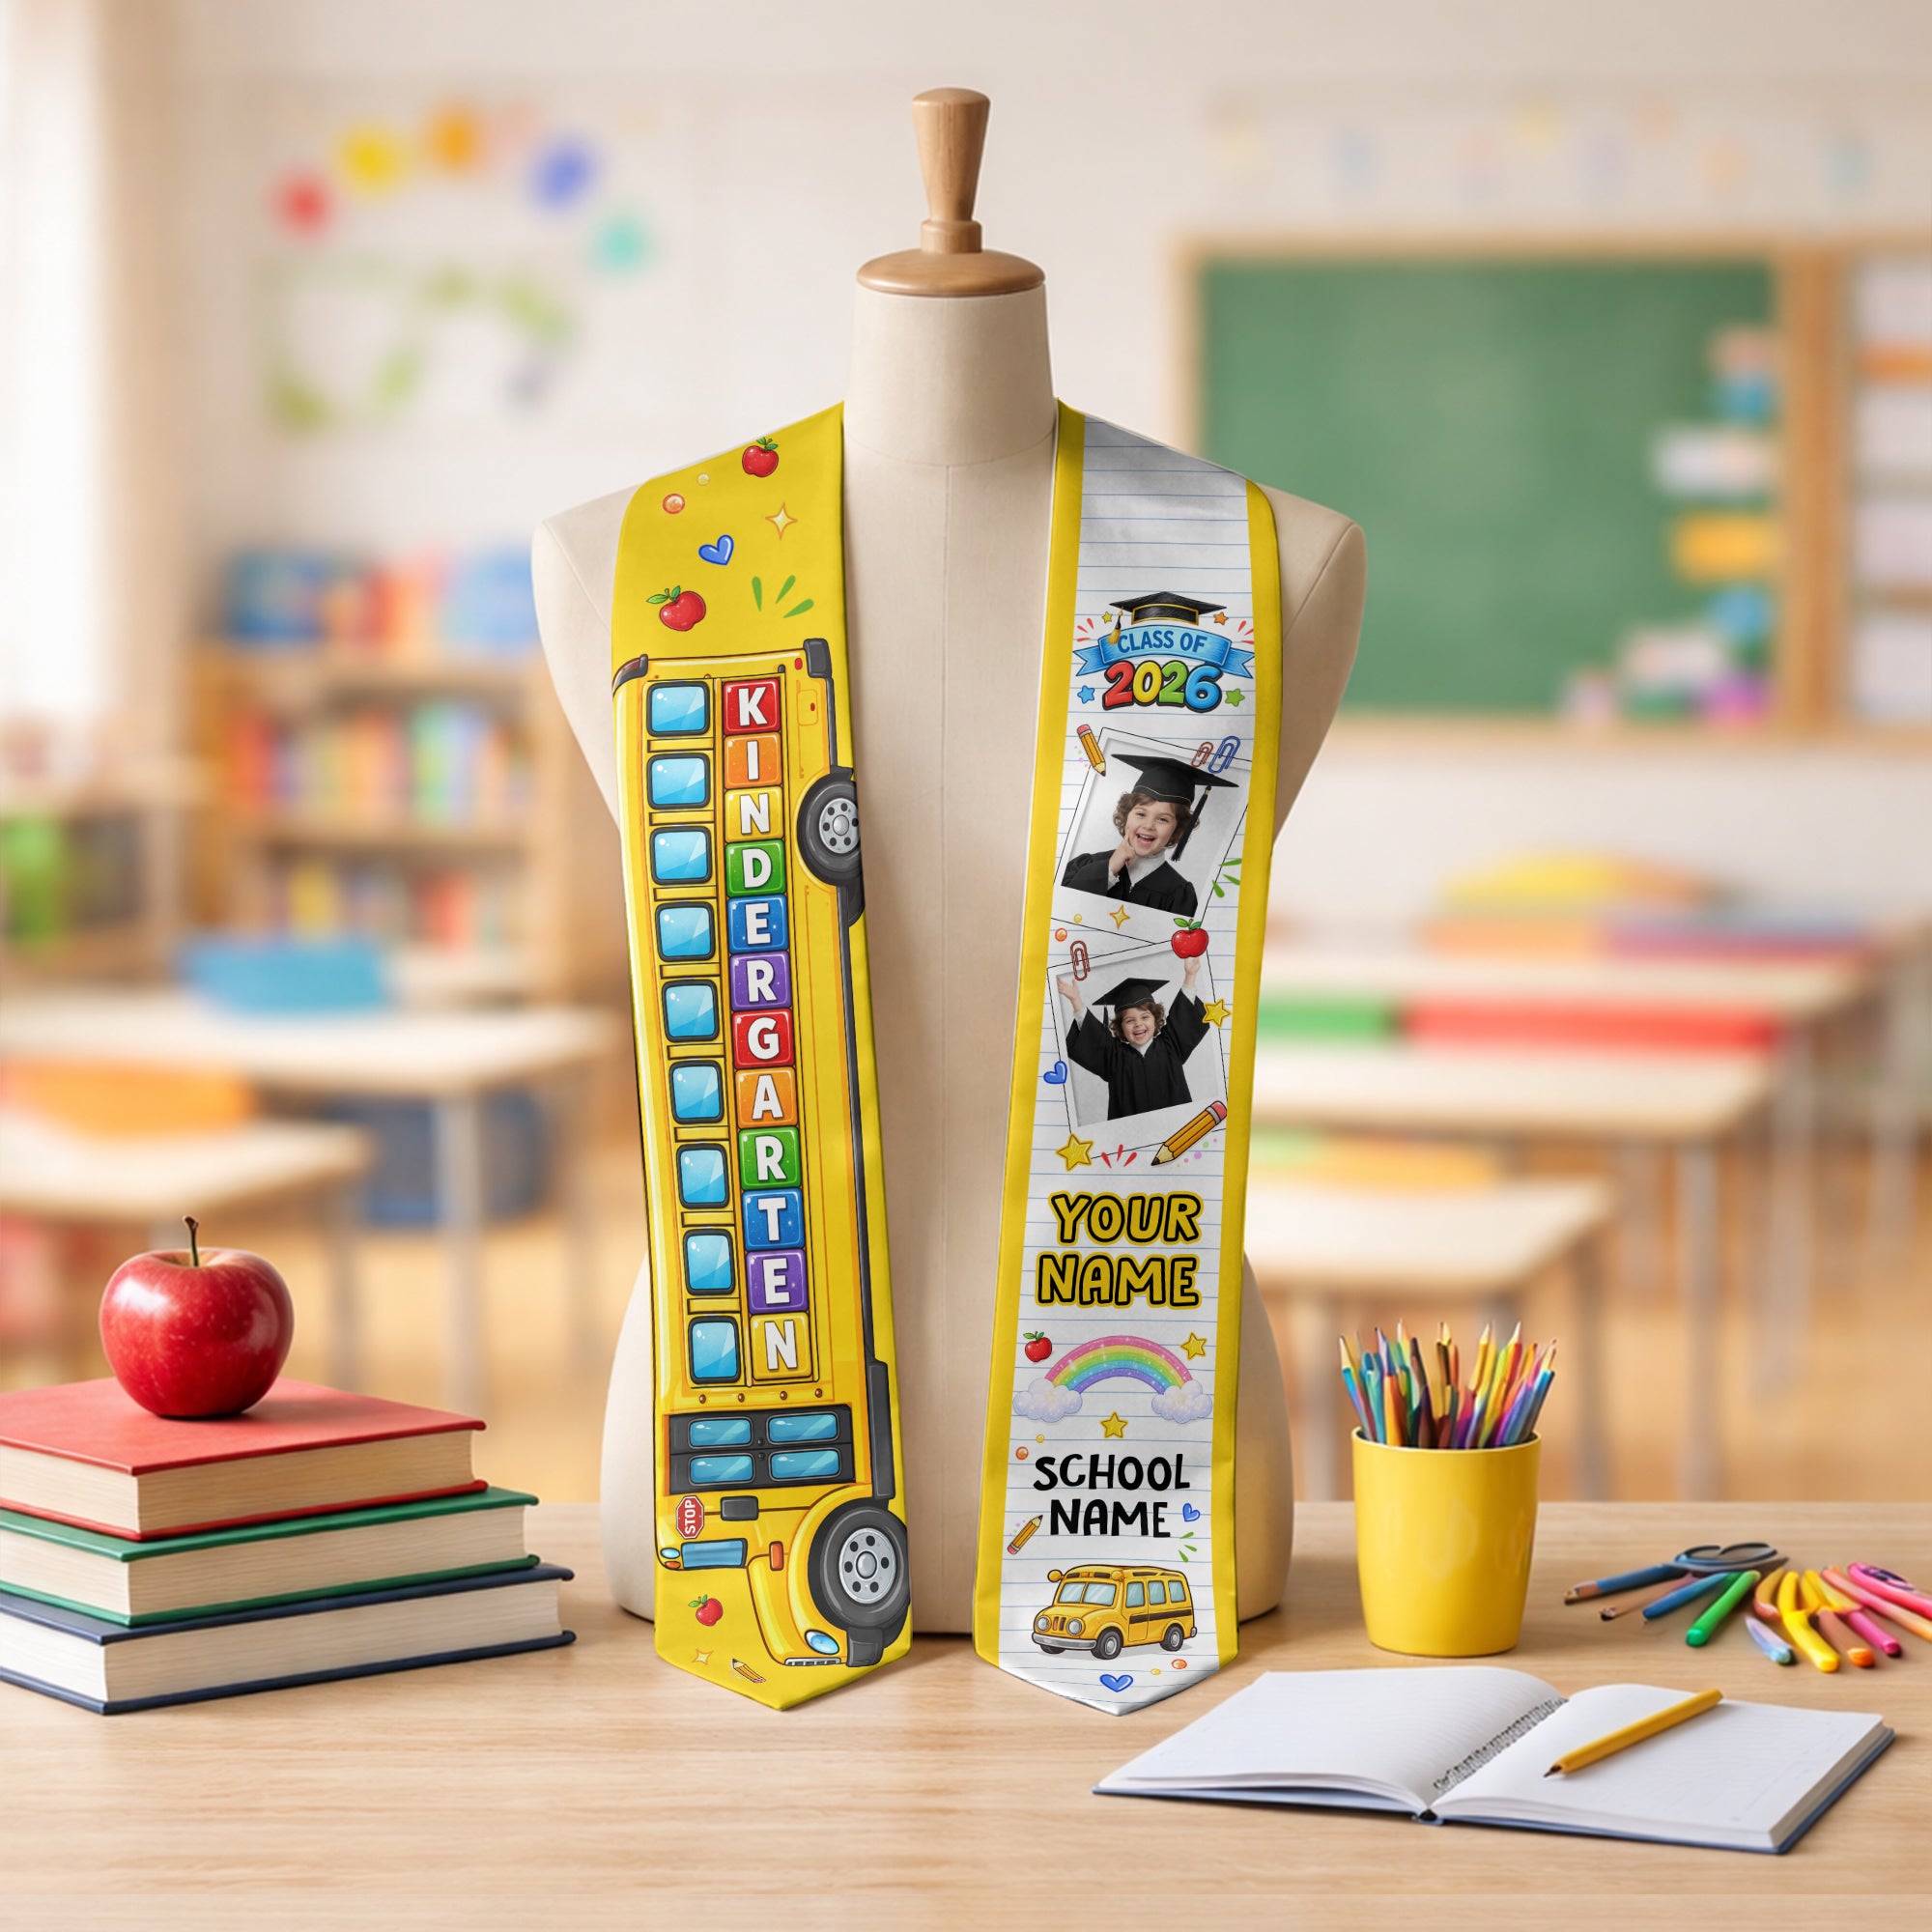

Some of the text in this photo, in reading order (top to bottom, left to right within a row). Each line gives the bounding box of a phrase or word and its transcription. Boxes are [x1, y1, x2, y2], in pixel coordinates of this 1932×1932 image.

[1118, 630, 1208, 653] CLASS OF
[1102, 660, 1223, 713] 2026
[738, 686, 798, 1370] KINDERGARTEN
[1050, 1192, 1203, 1244] YOUR
[1037, 1253, 1201, 1307] NAME
[1033, 1453, 1190, 1492] SCHOOL
[684, 1499, 696, 1535] STOP
[1049, 1498, 1172, 1537] NAME
